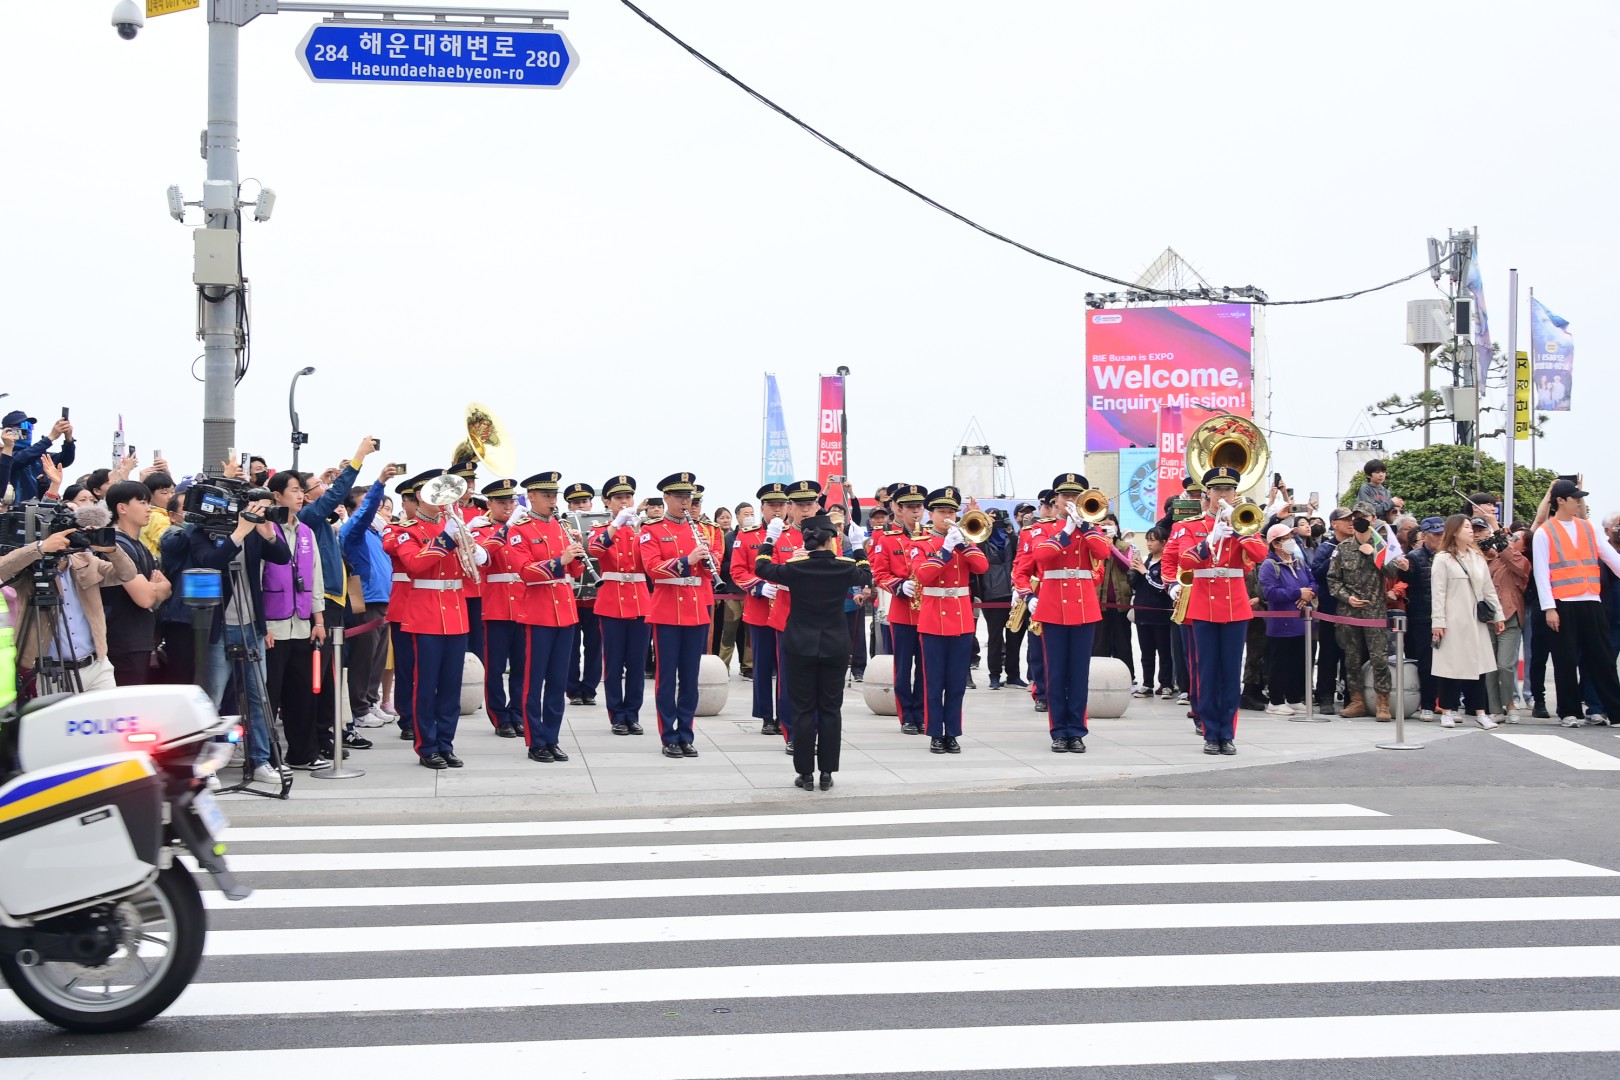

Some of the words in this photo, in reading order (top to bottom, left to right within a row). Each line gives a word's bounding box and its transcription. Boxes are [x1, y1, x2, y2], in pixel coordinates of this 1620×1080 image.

[314, 44, 349, 62] 284
[359, 31, 516, 61] 해운대해변로
[525, 50, 561, 68] 280
[351, 61, 524, 81] Haeundaehaebyeon-ro
[1092, 354, 1107, 363] BIE
[1109, 353, 1137, 362] Busan
[1138, 353, 1147, 361] is
[1149, 352, 1174, 361] EXPO
[1092, 364, 1243, 390] Welcome,
[1092, 393, 1163, 414] Enquiry
[1167, 391, 1246, 410] Mission!
[1161, 432, 1185, 454] BIE
[65, 716, 139, 736] POLICE
